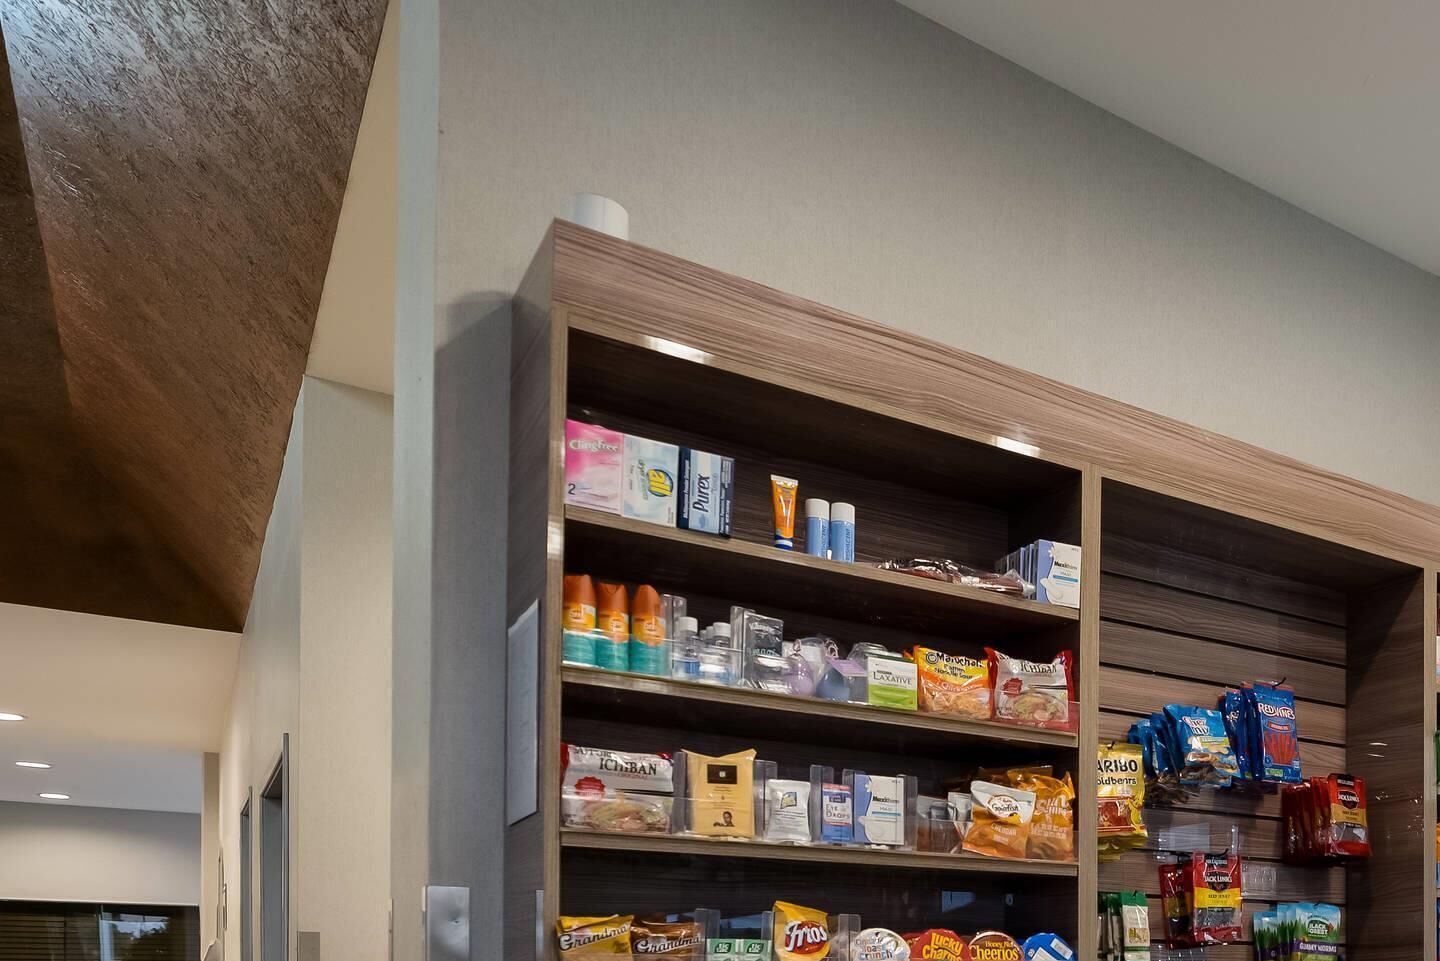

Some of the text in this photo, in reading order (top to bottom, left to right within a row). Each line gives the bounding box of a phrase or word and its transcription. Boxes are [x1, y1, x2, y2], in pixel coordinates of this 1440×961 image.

[567, 483, 576, 495] 2
[692, 473, 710, 513] Purex
[873, 671, 912, 686] LAXATIVE
[1097, 759, 1138, 773] ARIBO
[1097, 774, 1137, 786] oldbears
[784, 919, 828, 952] Fritos
[930, 932, 963, 958] Lucky
[969, 945, 1019, 961] Cheerios
